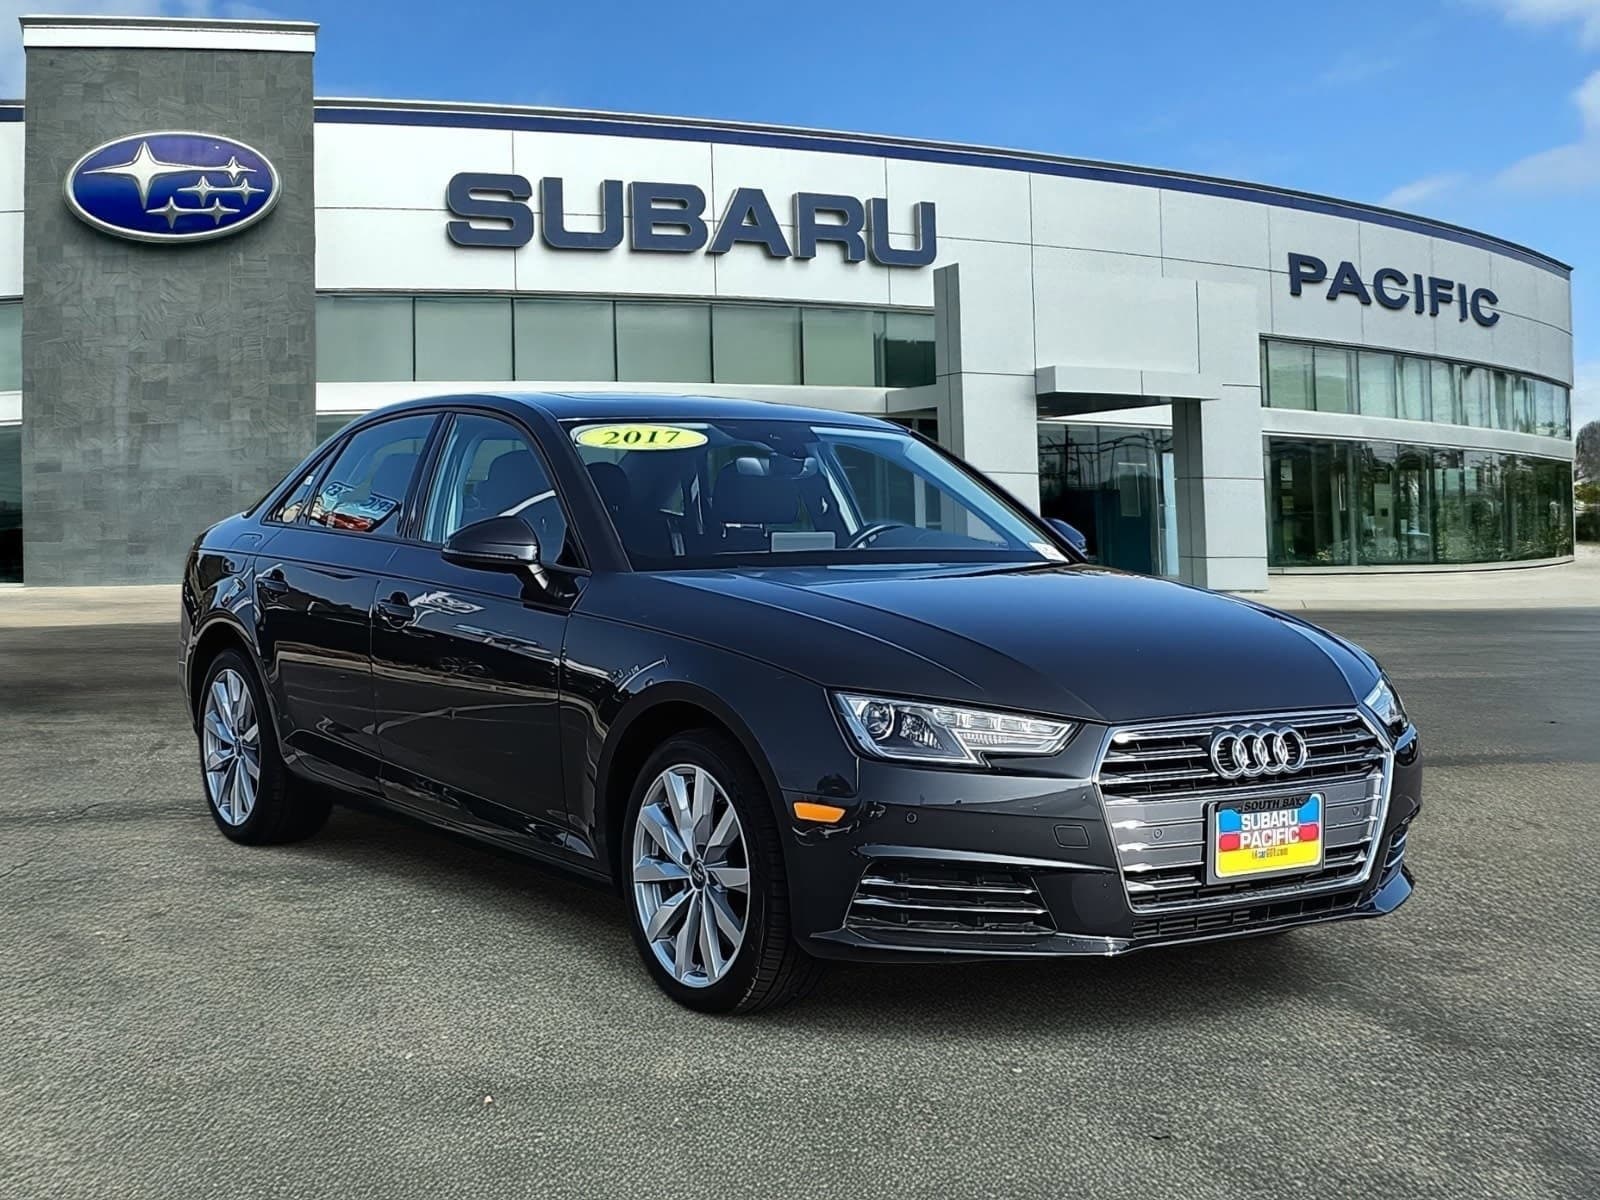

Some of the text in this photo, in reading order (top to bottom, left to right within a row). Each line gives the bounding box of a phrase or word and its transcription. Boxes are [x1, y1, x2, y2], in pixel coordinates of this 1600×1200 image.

[446, 172, 937, 267] SUBARU
[1288, 252, 1500, 327] PACIFIC
[602, 430, 681, 445] 2017
[1243, 796, 1302, 811] SOUTH BAY
[1241, 809, 1298, 831] SUBARU
[1240, 826, 1300, 850] PACIFIC
